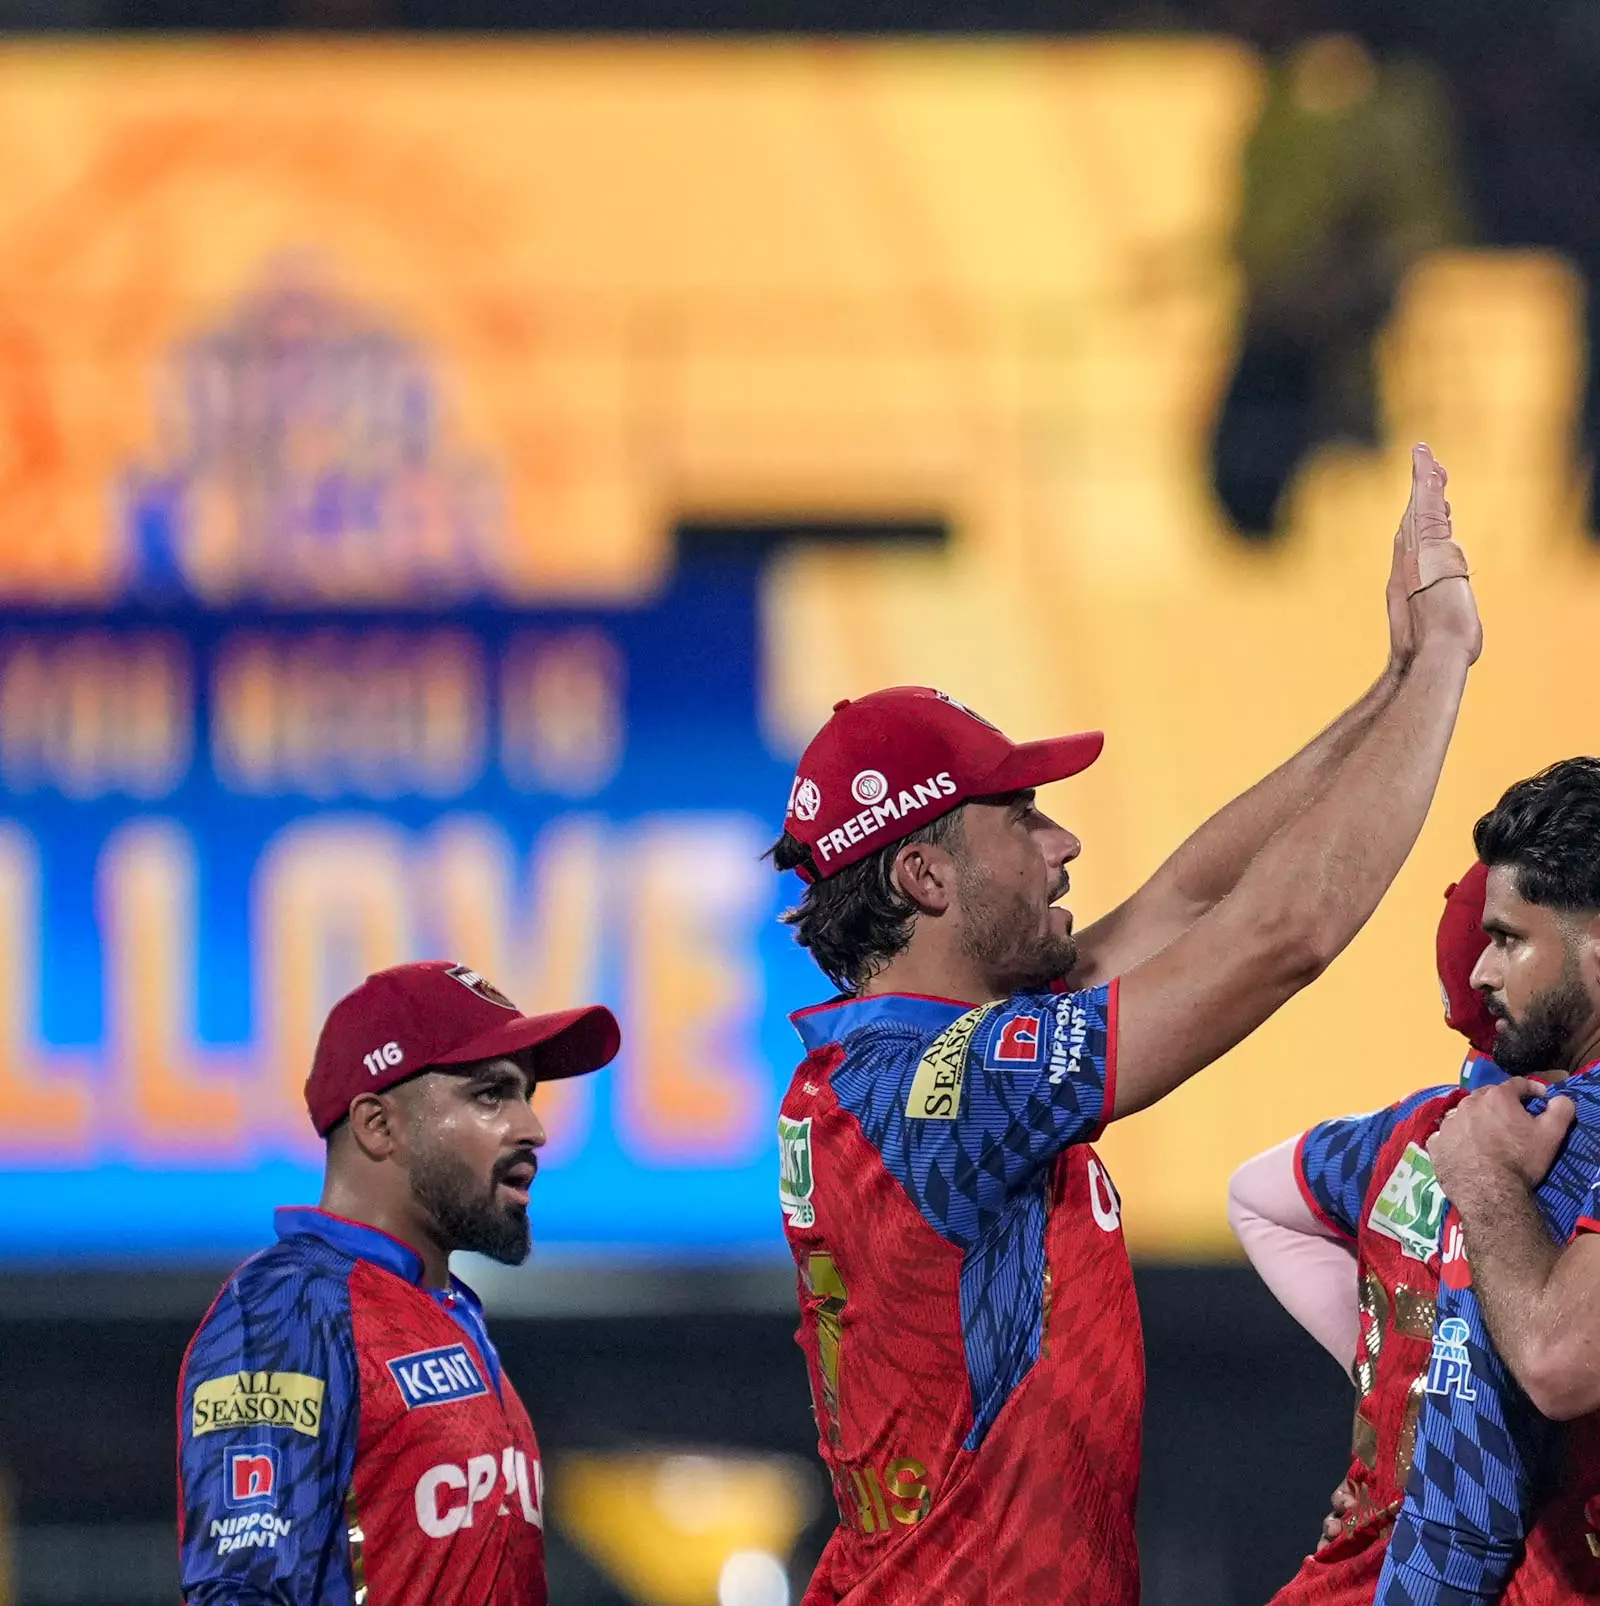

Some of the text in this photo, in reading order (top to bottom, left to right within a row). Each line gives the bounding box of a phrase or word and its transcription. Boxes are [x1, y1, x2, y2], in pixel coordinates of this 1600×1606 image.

[816, 772, 957, 861] FREEMANS
[363, 1041, 403, 1075] 116
[231, 1372, 281, 1395] ALL
[399, 1353, 478, 1399] KENT
[1427, 1357, 1476, 1401] IPL
[194, 1397, 318, 1427] SEASONS
[415, 1454, 498, 1539] CP
[209, 1512, 292, 1537] NIPPON
[217, 1530, 277, 1555] PAINT
